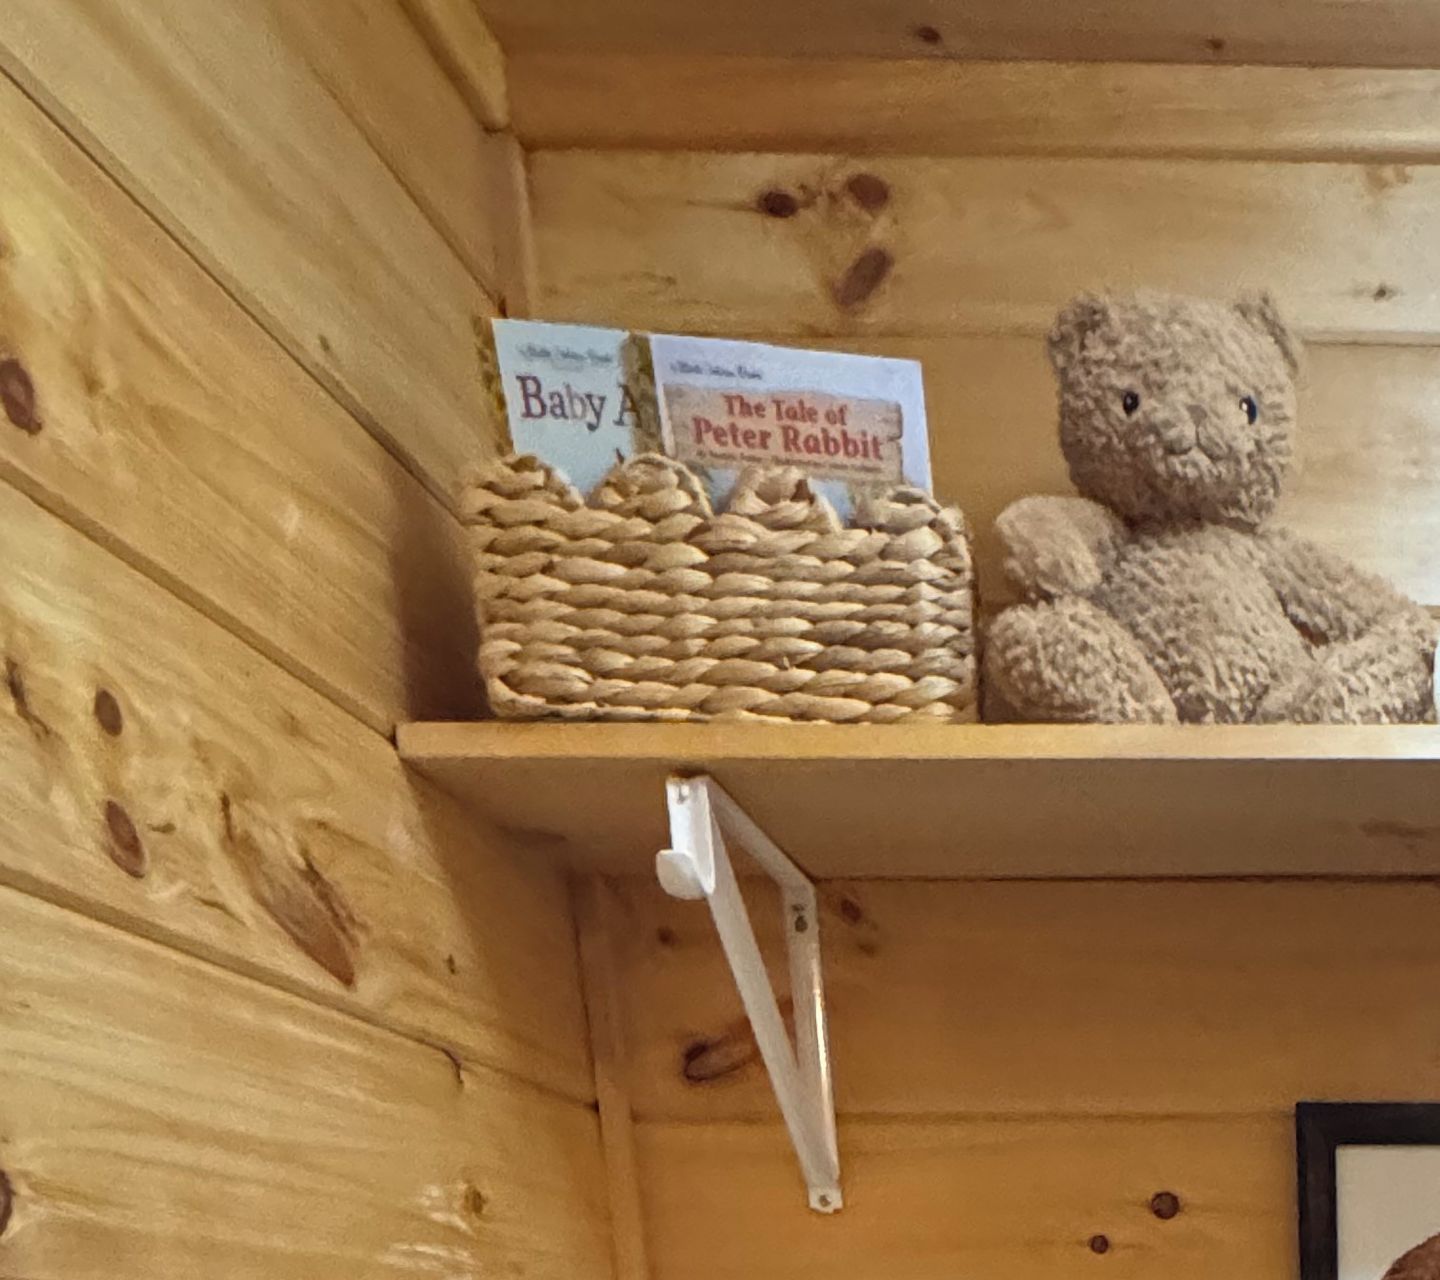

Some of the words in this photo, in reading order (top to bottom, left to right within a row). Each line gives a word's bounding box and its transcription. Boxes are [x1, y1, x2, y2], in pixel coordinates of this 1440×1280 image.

[516, 374, 606, 431] Baby
[722, 393, 767, 418] The
[771, 399, 818, 424] Tale
[824, 404, 848, 426] of
[691, 415, 772, 450] Peter
[782, 425, 884, 461] Rabbit
